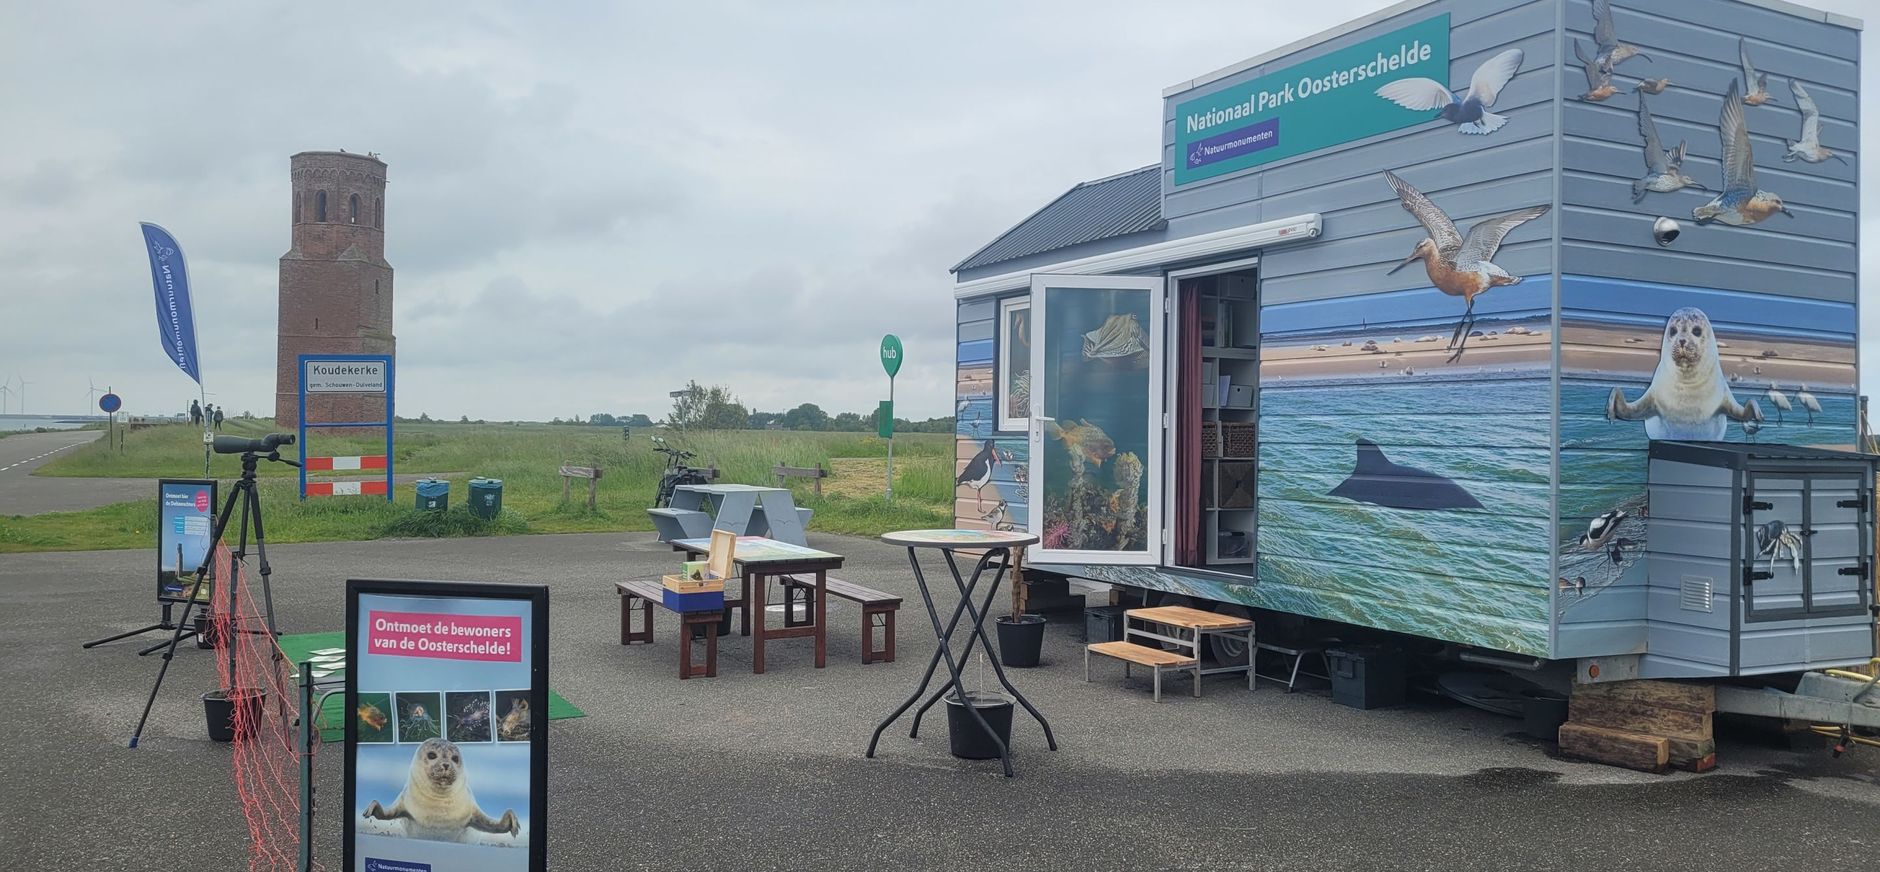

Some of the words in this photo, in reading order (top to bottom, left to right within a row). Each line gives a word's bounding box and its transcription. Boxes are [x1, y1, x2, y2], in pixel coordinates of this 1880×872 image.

[1186, 94, 1255, 134] Nationaal
[1258, 83, 1295, 112] Park
[1297, 40, 1432, 98] Oosterschelde
[1204, 129, 1273, 157] Natuurmonumenten
[882, 346, 897, 359] hub
[313, 365, 378, 375] Koudekerke
[375, 618, 432, 634] Ontmoet
[434, 622, 449, 634] de
[451, 622, 512, 637] bewoners
[374, 637, 397, 649] van
[400, 637, 415, 650] de
[418, 638, 511, 655] Oosterschelde!
